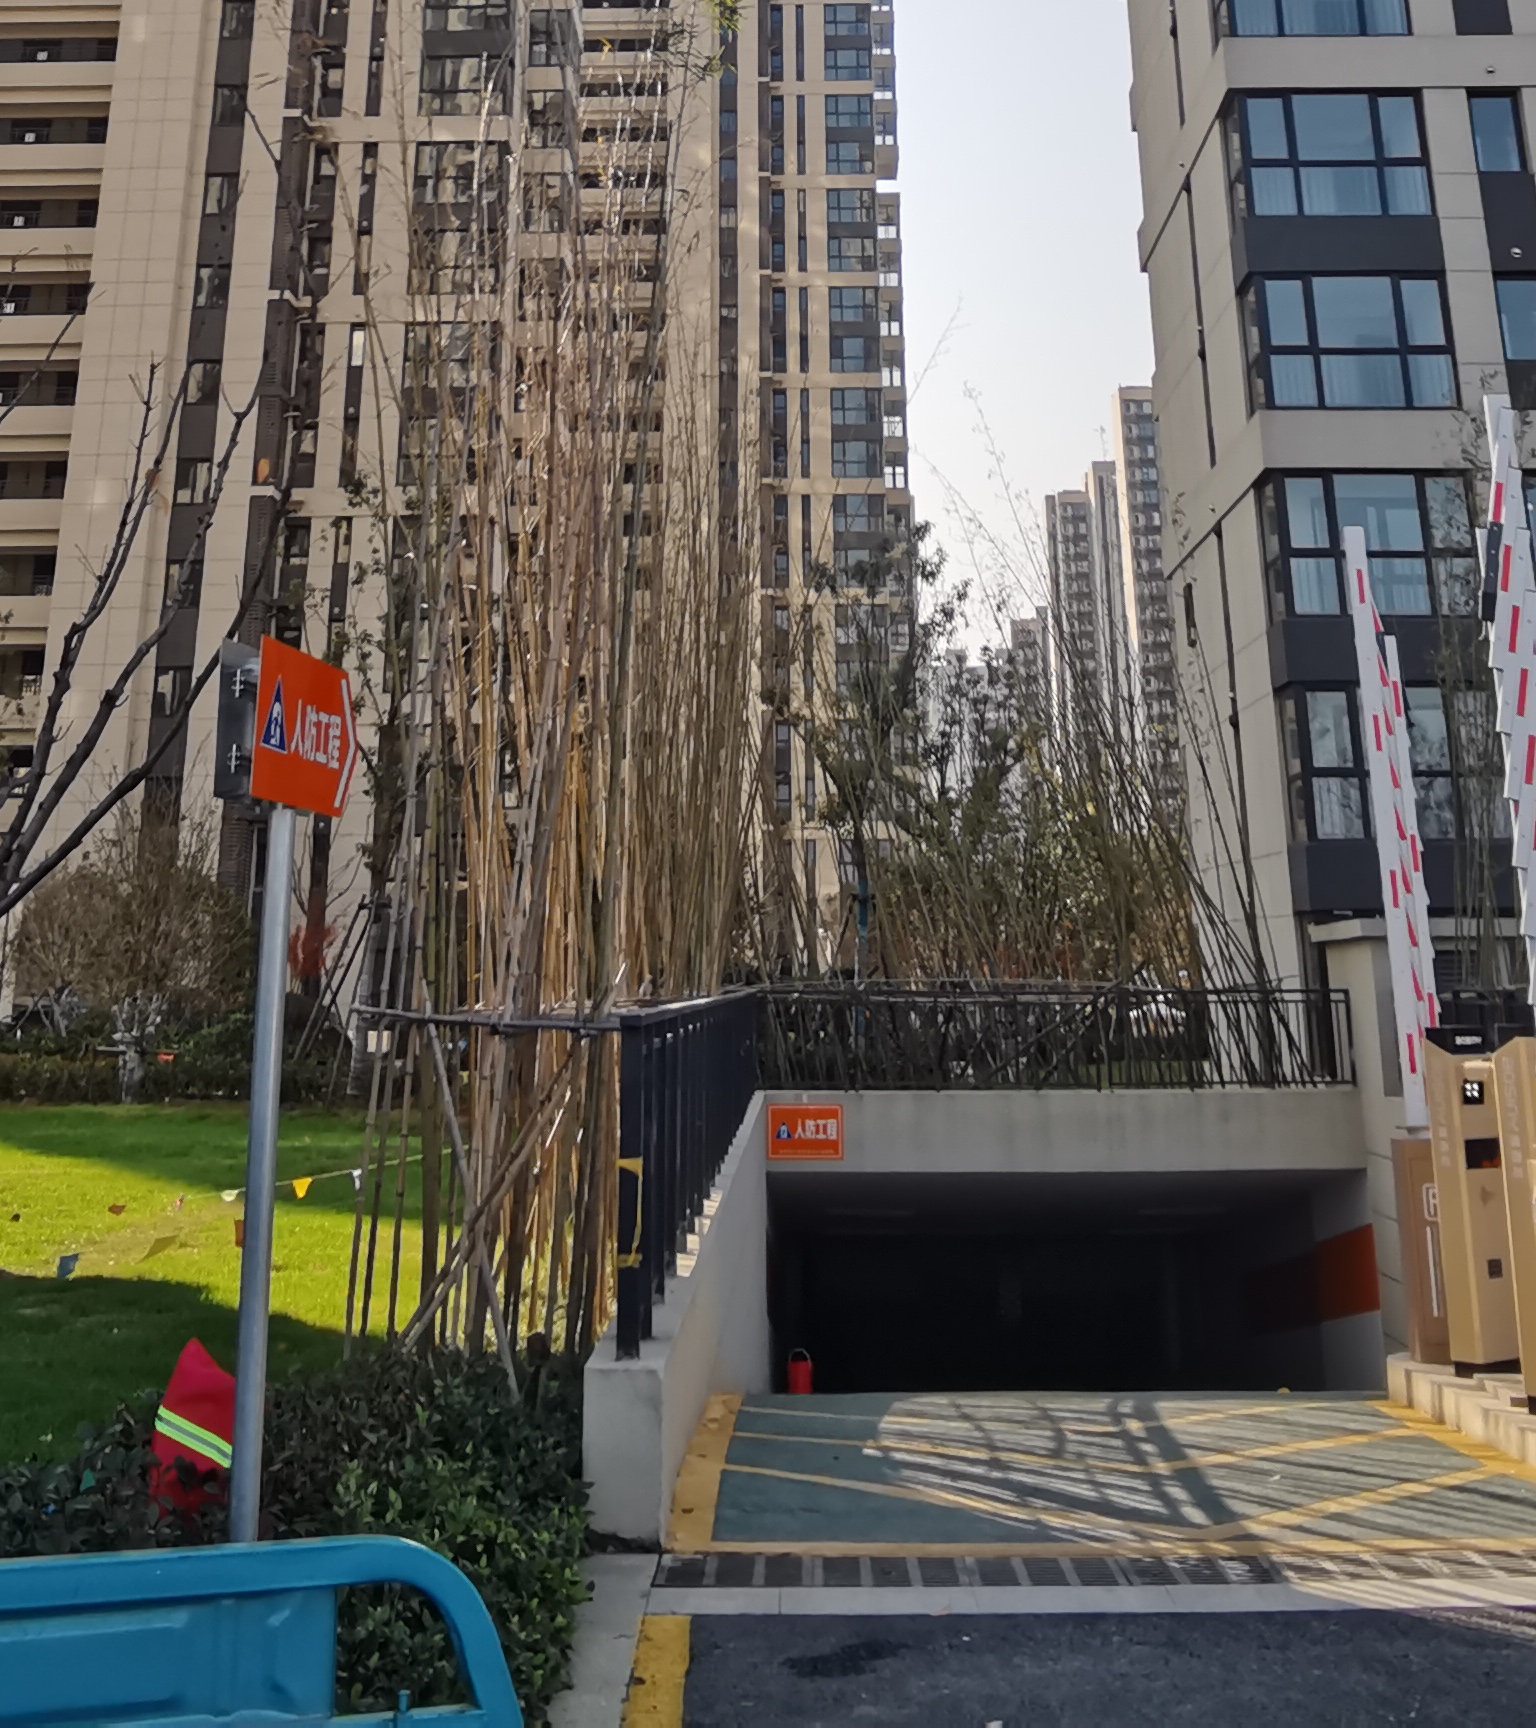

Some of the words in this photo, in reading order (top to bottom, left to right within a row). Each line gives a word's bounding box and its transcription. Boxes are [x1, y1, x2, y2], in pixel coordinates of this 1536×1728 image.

[291, 699, 342, 770] 人防工程
[794, 1118, 838, 1141] 人防工程
